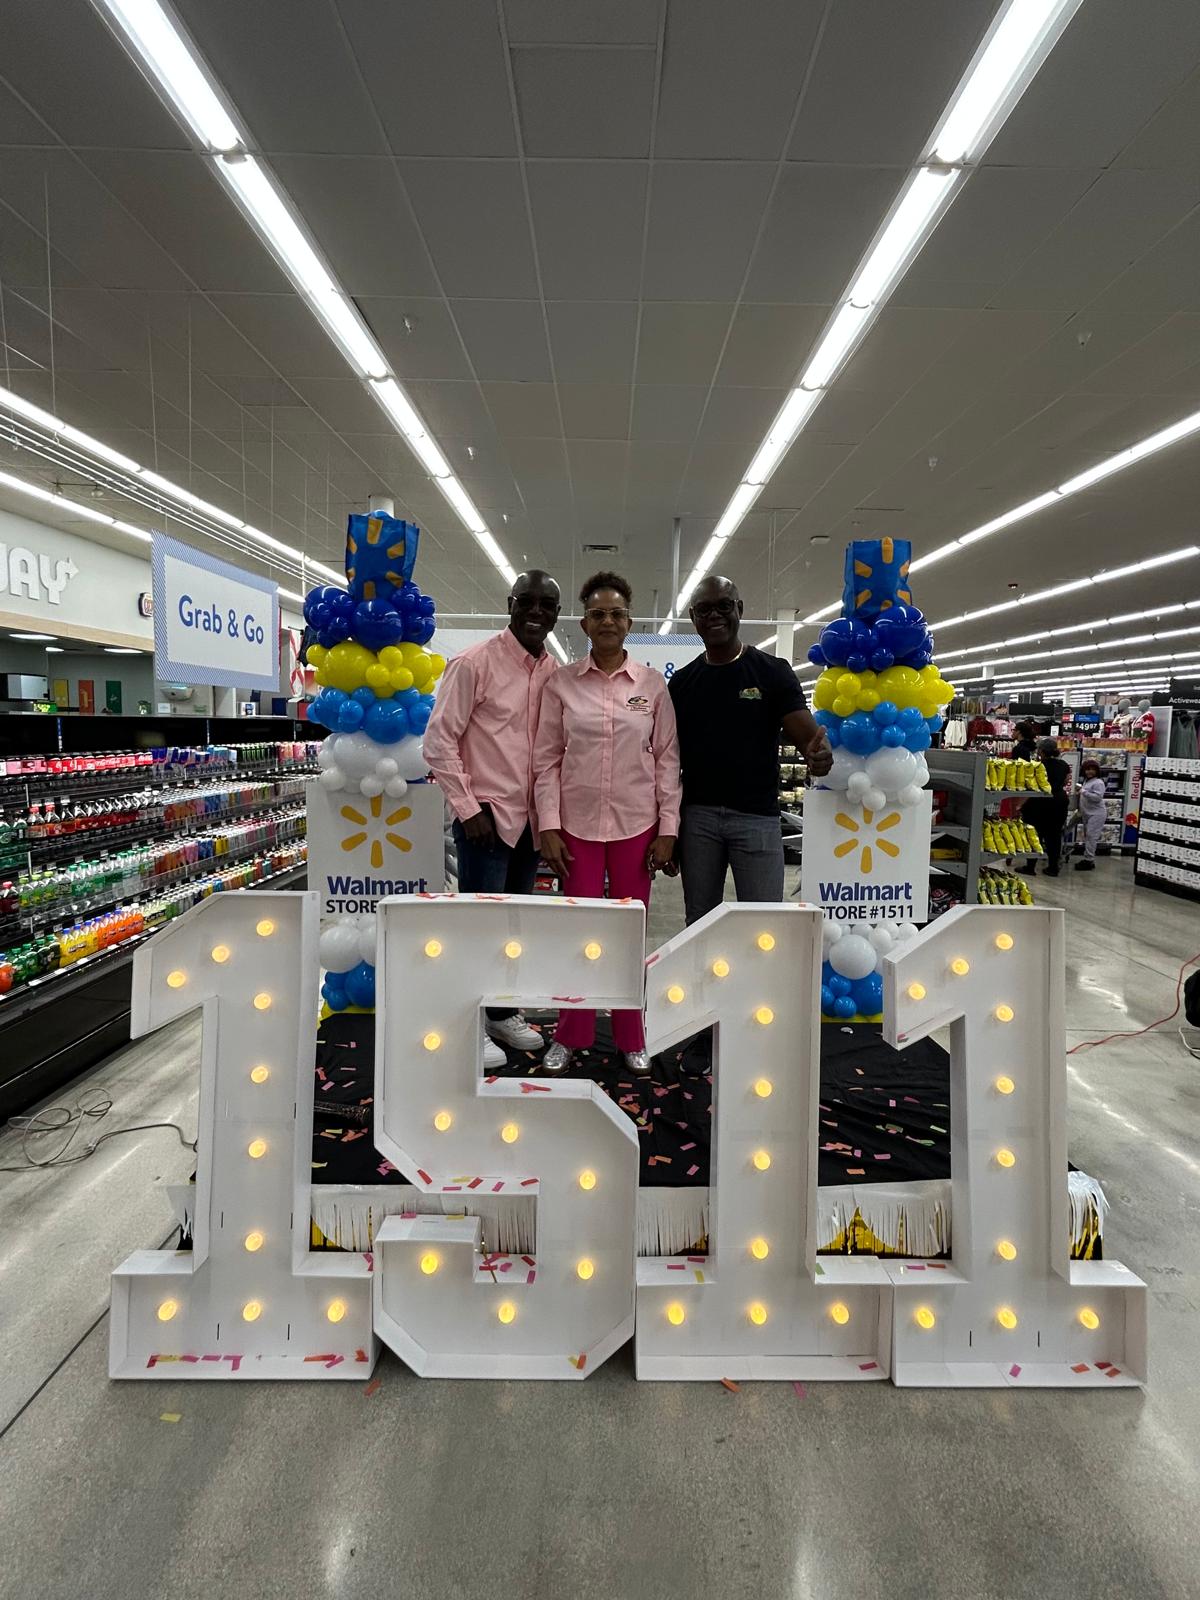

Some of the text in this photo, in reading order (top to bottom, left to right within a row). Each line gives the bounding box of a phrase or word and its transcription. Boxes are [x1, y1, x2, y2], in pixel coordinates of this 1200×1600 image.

[179, 595, 222, 634] Grab
[228, 609, 239, 638] &
[244, 614, 264, 644] Go
[1131, 783, 1140, 799] Red
[327, 876, 427, 896] Walmart
[819, 882, 912, 901] Walmart
[326, 899, 378, 914] STORE
[869, 905, 913, 919] #1511
[109, 891, 1146, 1388] 1511
